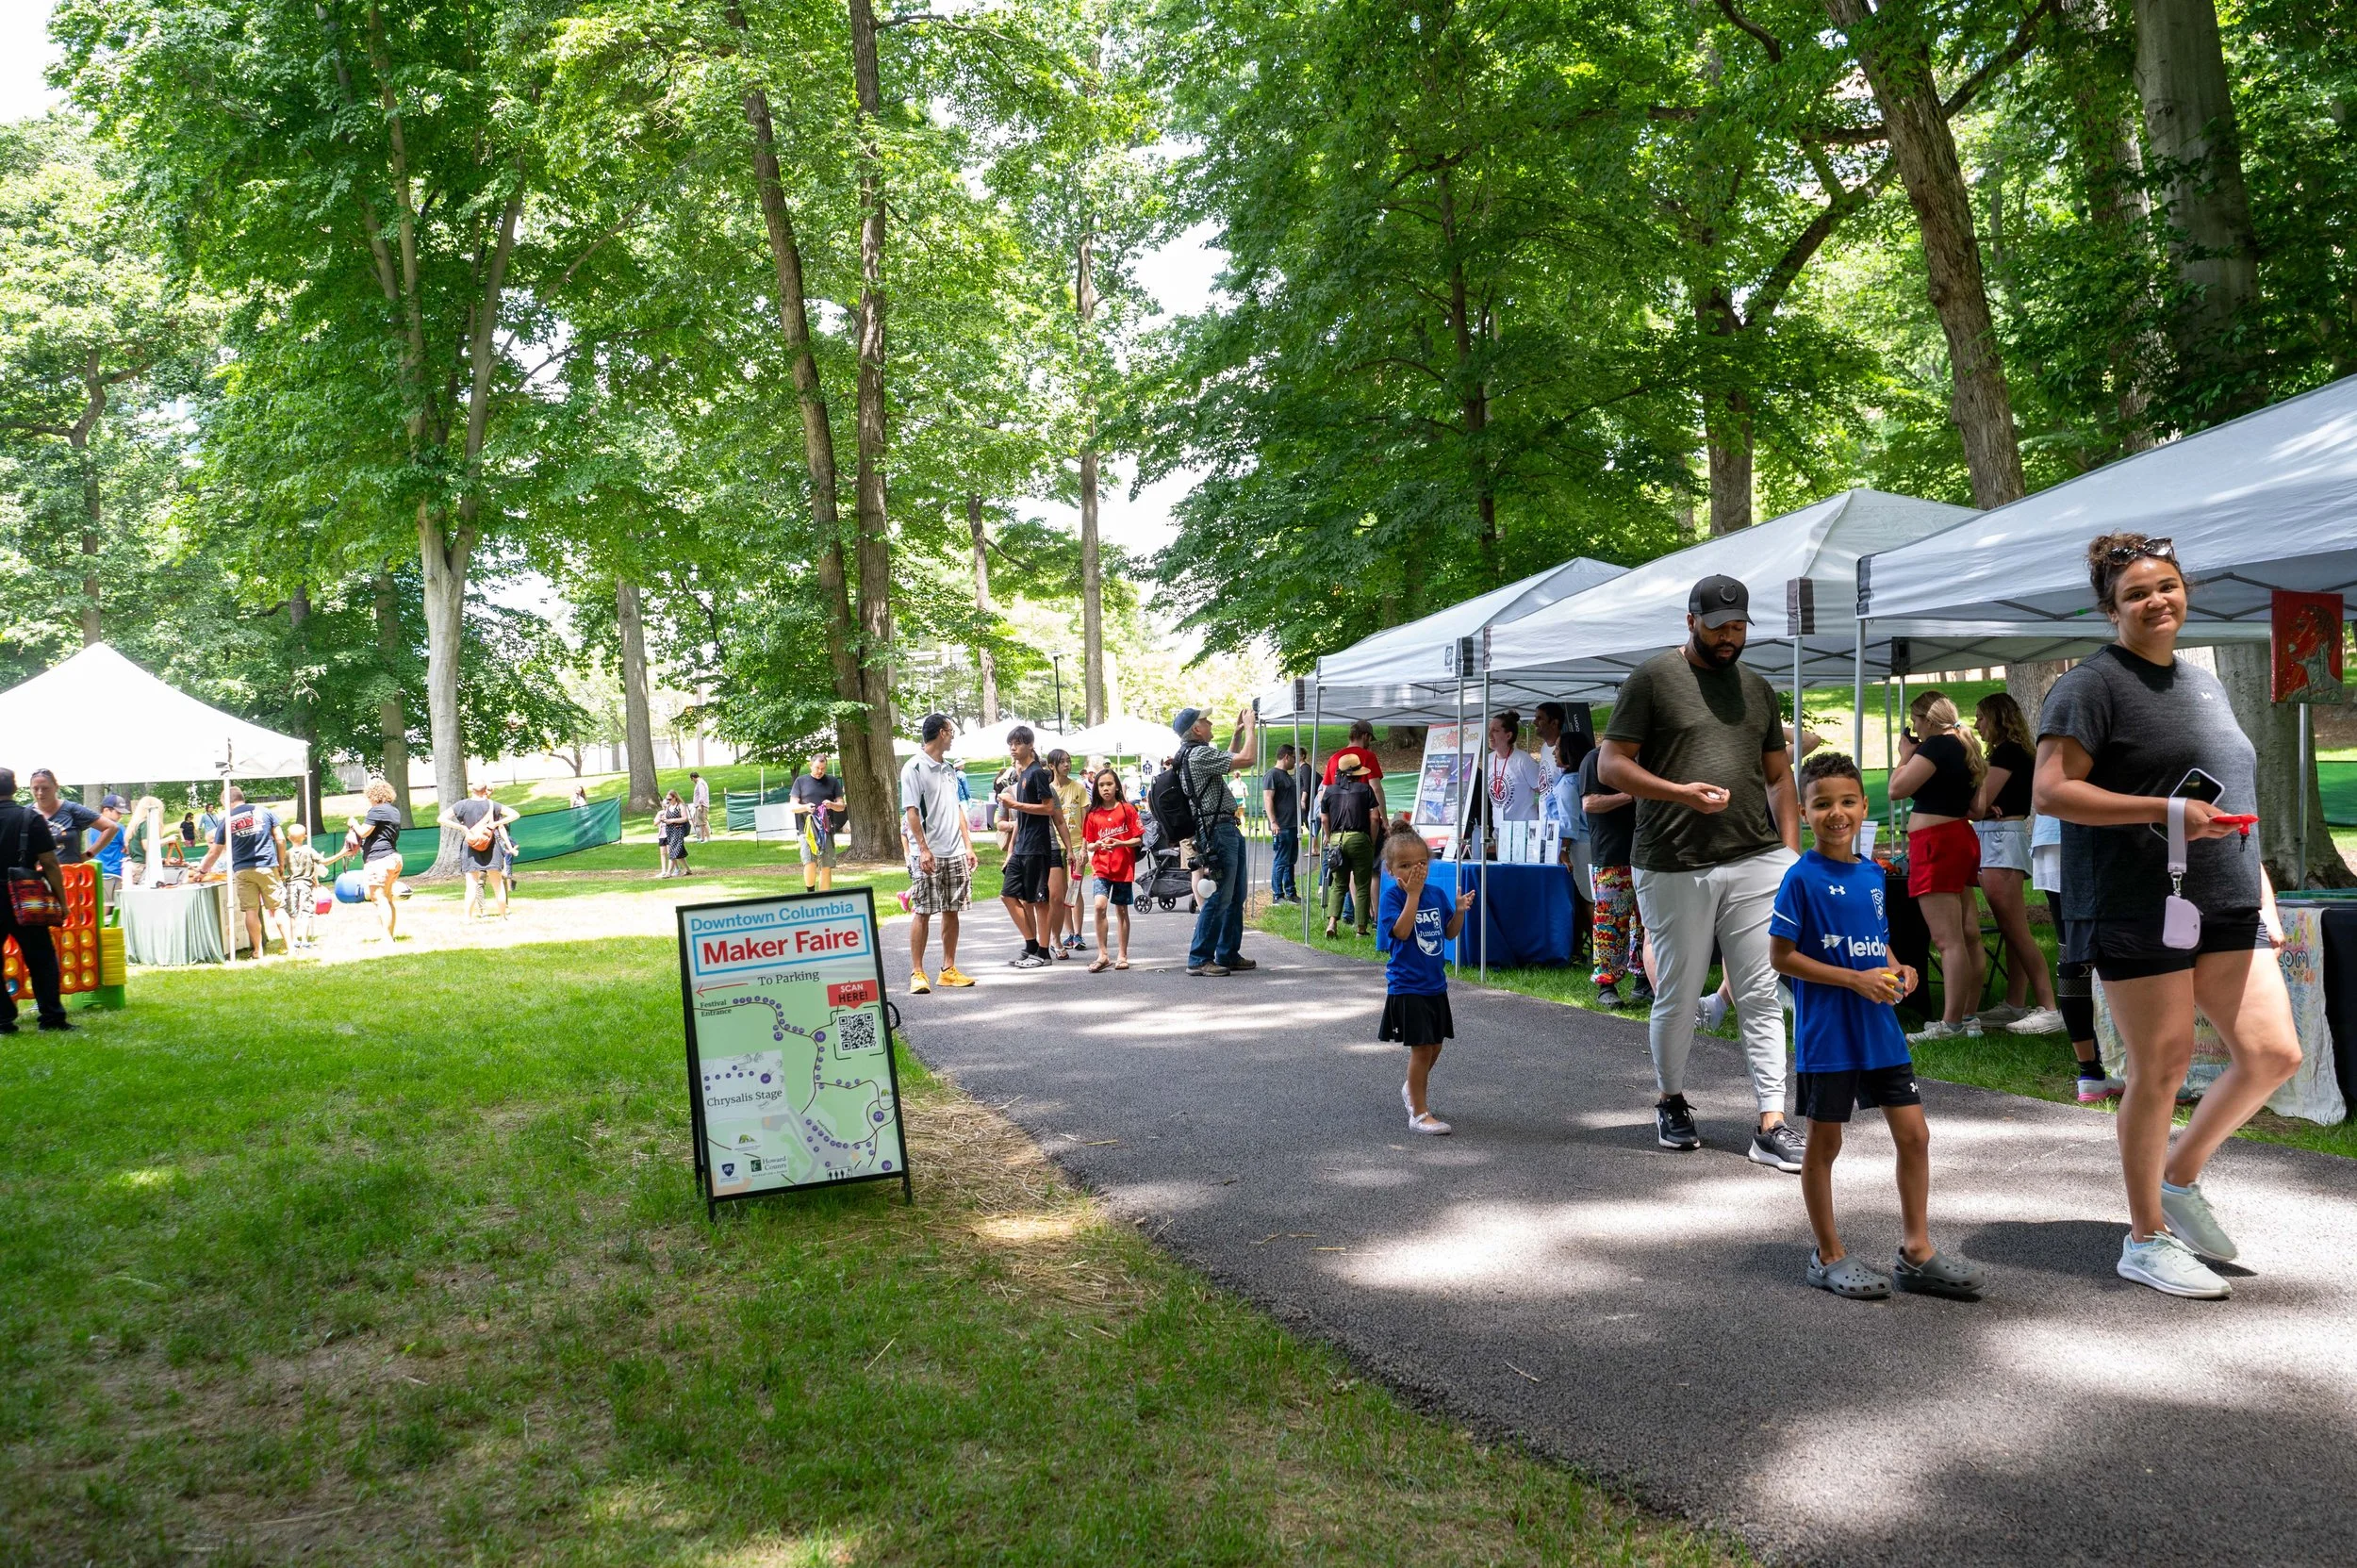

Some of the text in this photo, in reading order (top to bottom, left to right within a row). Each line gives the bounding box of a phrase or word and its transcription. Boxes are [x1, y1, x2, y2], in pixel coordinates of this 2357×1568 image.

[691, 901, 854, 932] Downtown Columbia
[703, 937, 788, 965] Maker
[757, 971, 820, 986] To Parking
[840, 983, 864, 993] SCAN
[838, 991, 868, 1003] HERE!
[700, 999, 727, 1008] Festival
[701, 1009, 733, 1017] Entrance
[707, 1090, 783, 1107] Chrysalis Stage
[763, 1156, 786, 1164] Howard
